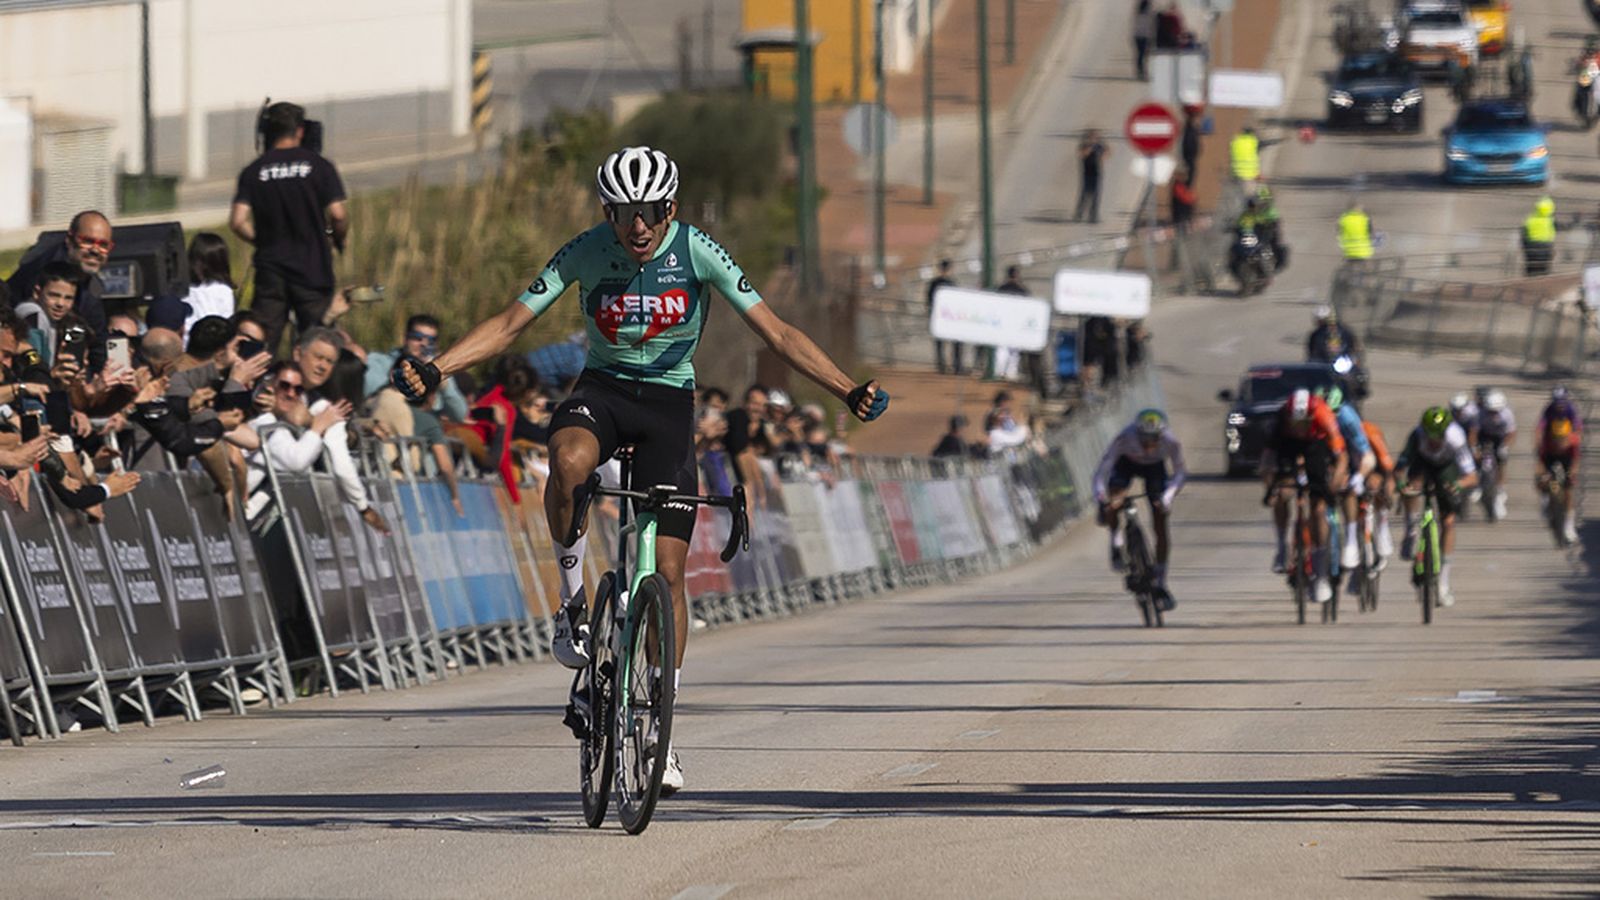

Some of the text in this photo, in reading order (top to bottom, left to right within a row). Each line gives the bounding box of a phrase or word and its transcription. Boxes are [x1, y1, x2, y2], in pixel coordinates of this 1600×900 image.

[259, 163, 311, 181] STAFF
[601, 294, 686, 314] KERN
[601, 311, 686, 324] PHARMA
